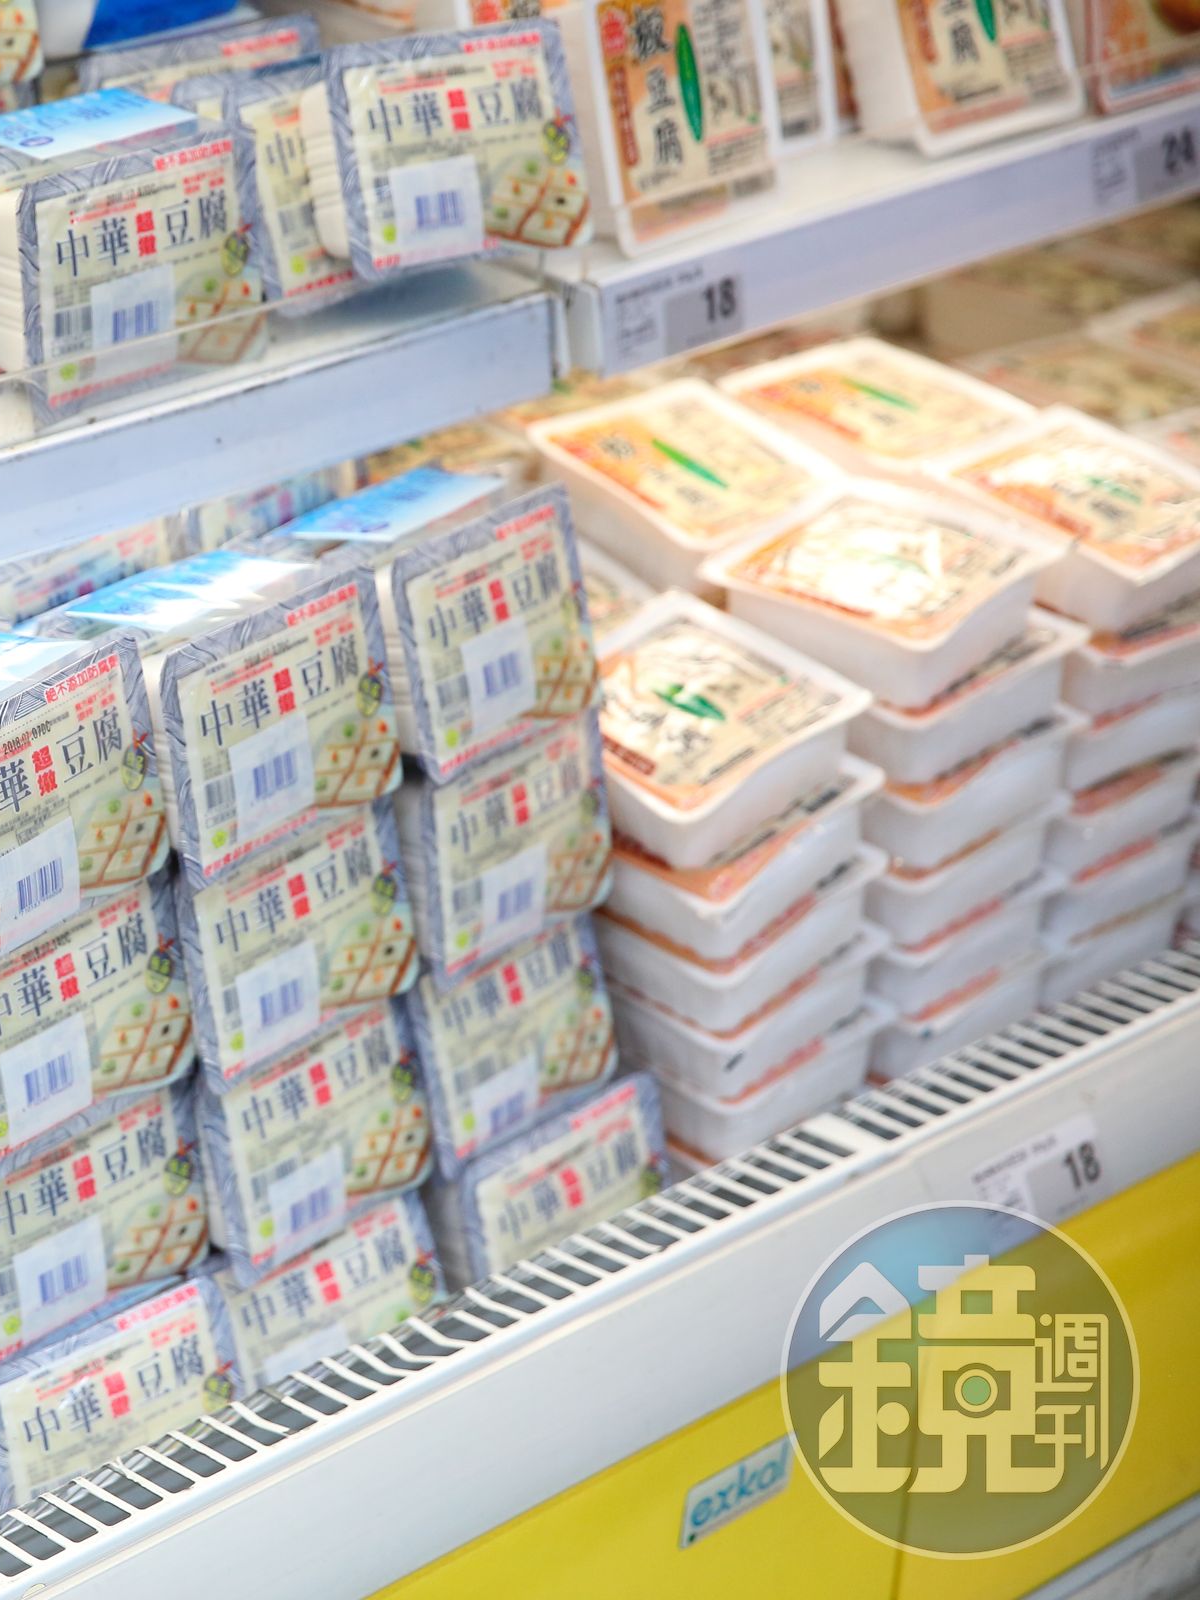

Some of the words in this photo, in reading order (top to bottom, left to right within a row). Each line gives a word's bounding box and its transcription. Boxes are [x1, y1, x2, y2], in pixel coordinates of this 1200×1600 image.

[55, 216, 130, 277] 中華
[702, 278, 739, 323] 18
[200, 678, 271, 747] 中華
[56, 706, 123, 784] 豆腐
[1062, 1140, 1101, 1191] 18
